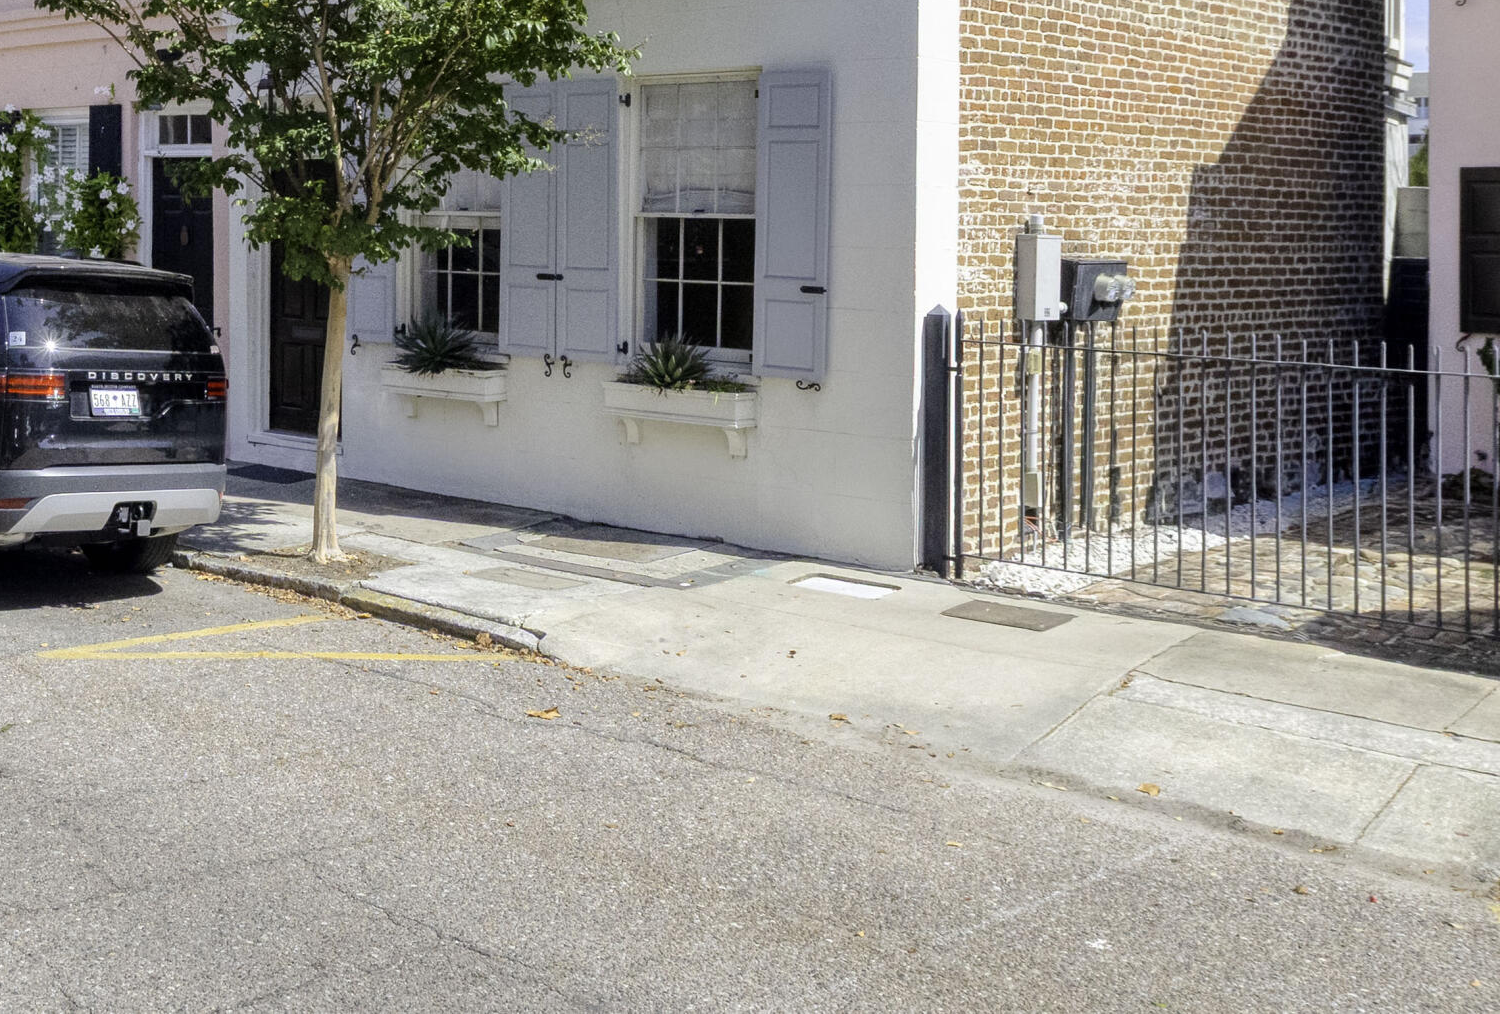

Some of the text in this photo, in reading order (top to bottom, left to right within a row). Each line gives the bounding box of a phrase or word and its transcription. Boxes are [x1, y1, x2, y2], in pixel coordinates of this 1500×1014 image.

[87, 371, 194, 381] DISCOVERY
[93, 393, 137, 407] 568 AZZ
